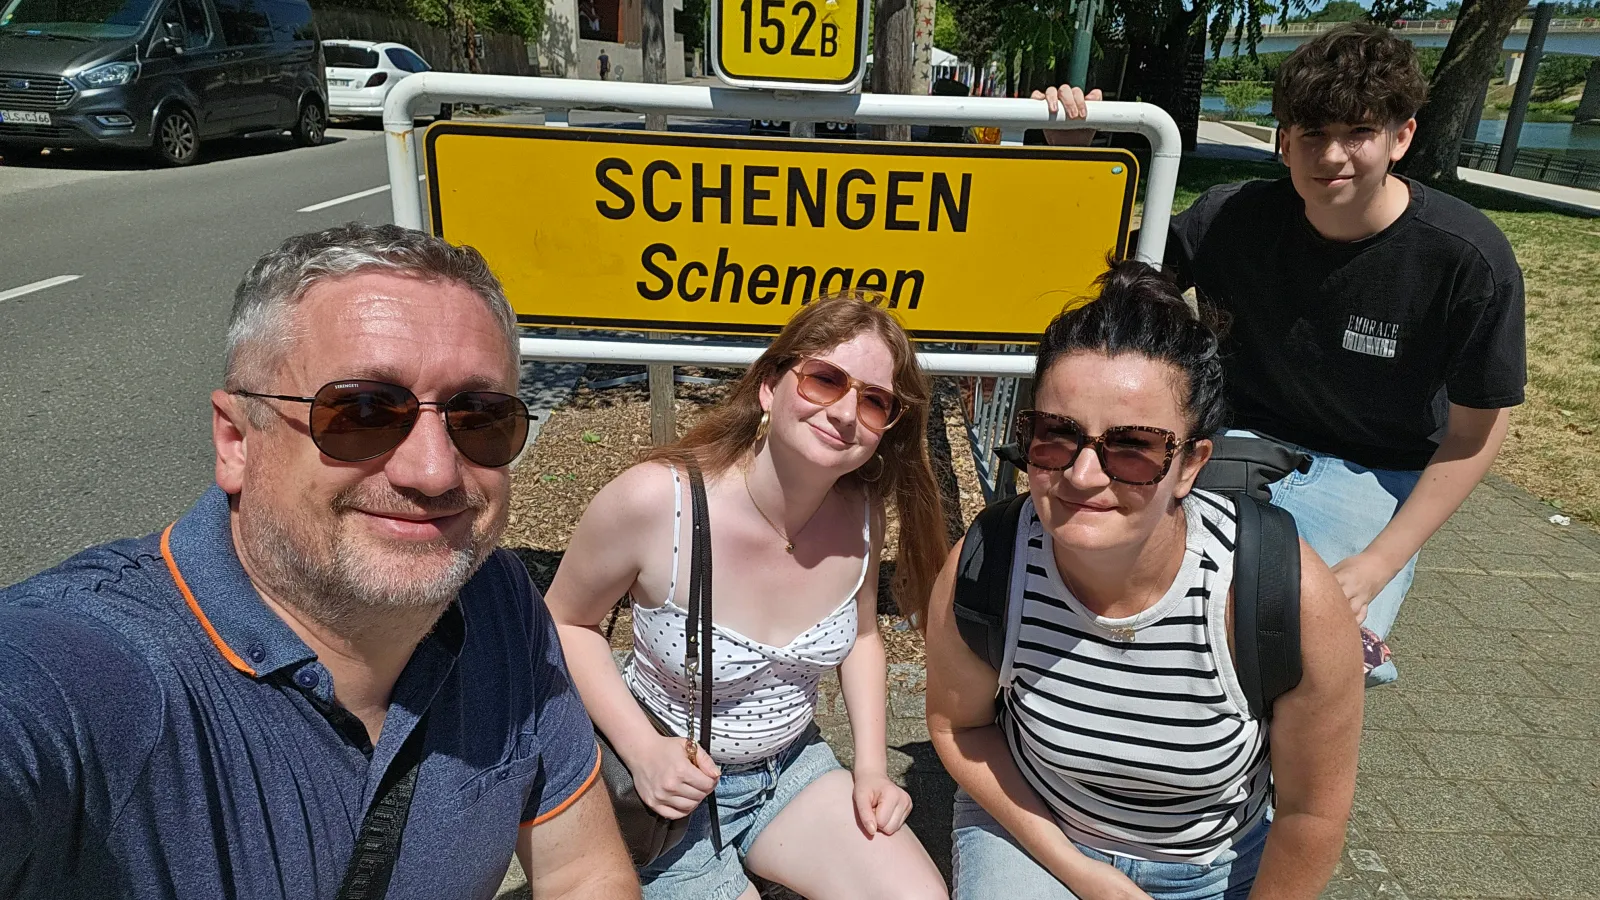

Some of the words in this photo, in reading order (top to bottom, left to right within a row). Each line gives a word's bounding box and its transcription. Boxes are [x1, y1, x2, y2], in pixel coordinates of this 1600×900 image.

[740, 0, 838, 57] 152B
[3, 112, 20, 121] SLS
[38, 114, 50, 123] 66
[595, 157, 972, 233] SCHENGEN
[1347, 314, 1399, 339] EMBRACE
